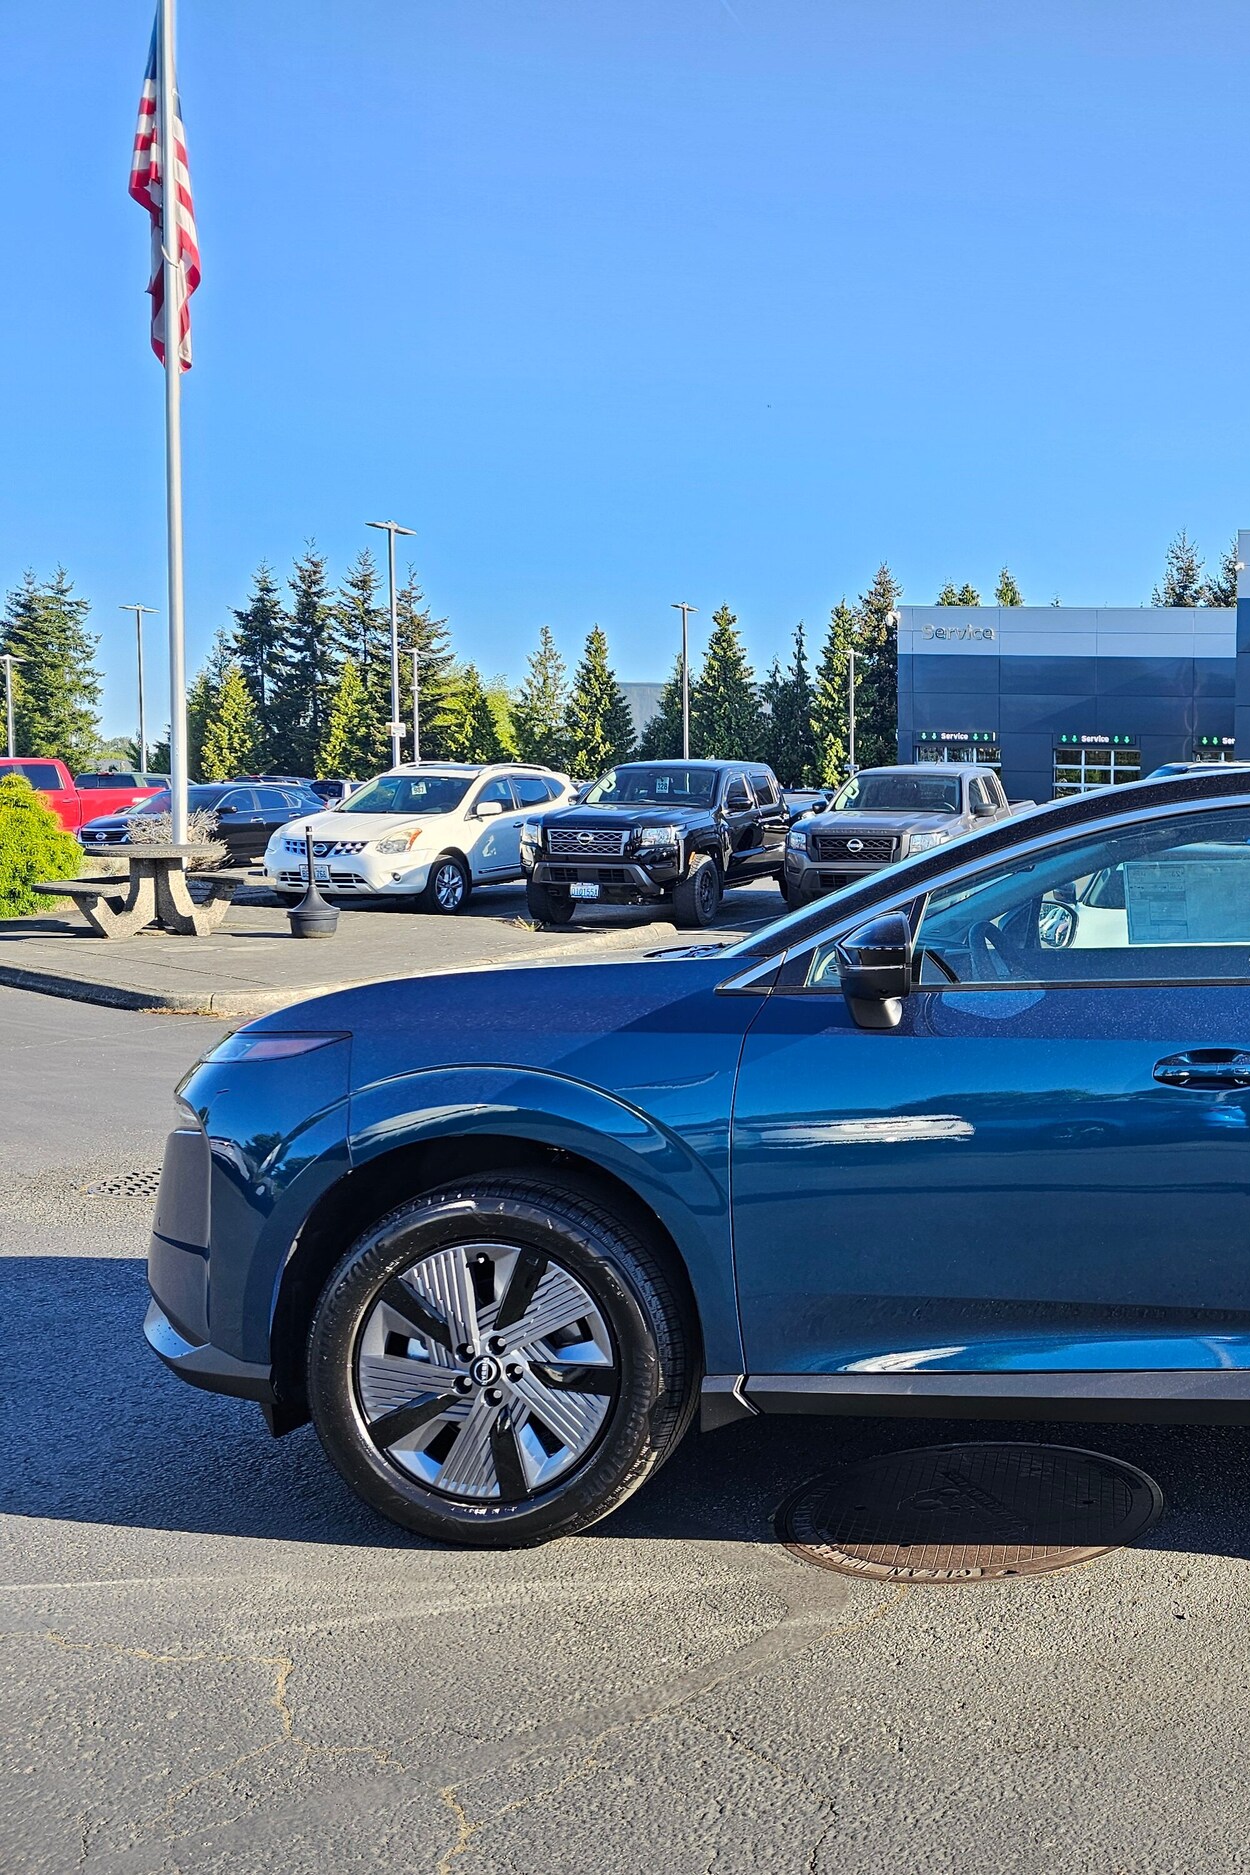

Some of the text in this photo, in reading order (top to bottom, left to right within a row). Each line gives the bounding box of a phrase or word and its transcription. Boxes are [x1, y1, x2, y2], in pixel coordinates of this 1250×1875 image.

[922, 623, 996, 640] Service
[940, 732, 969, 740] Service
[1081, 734, 1110, 743] Service
